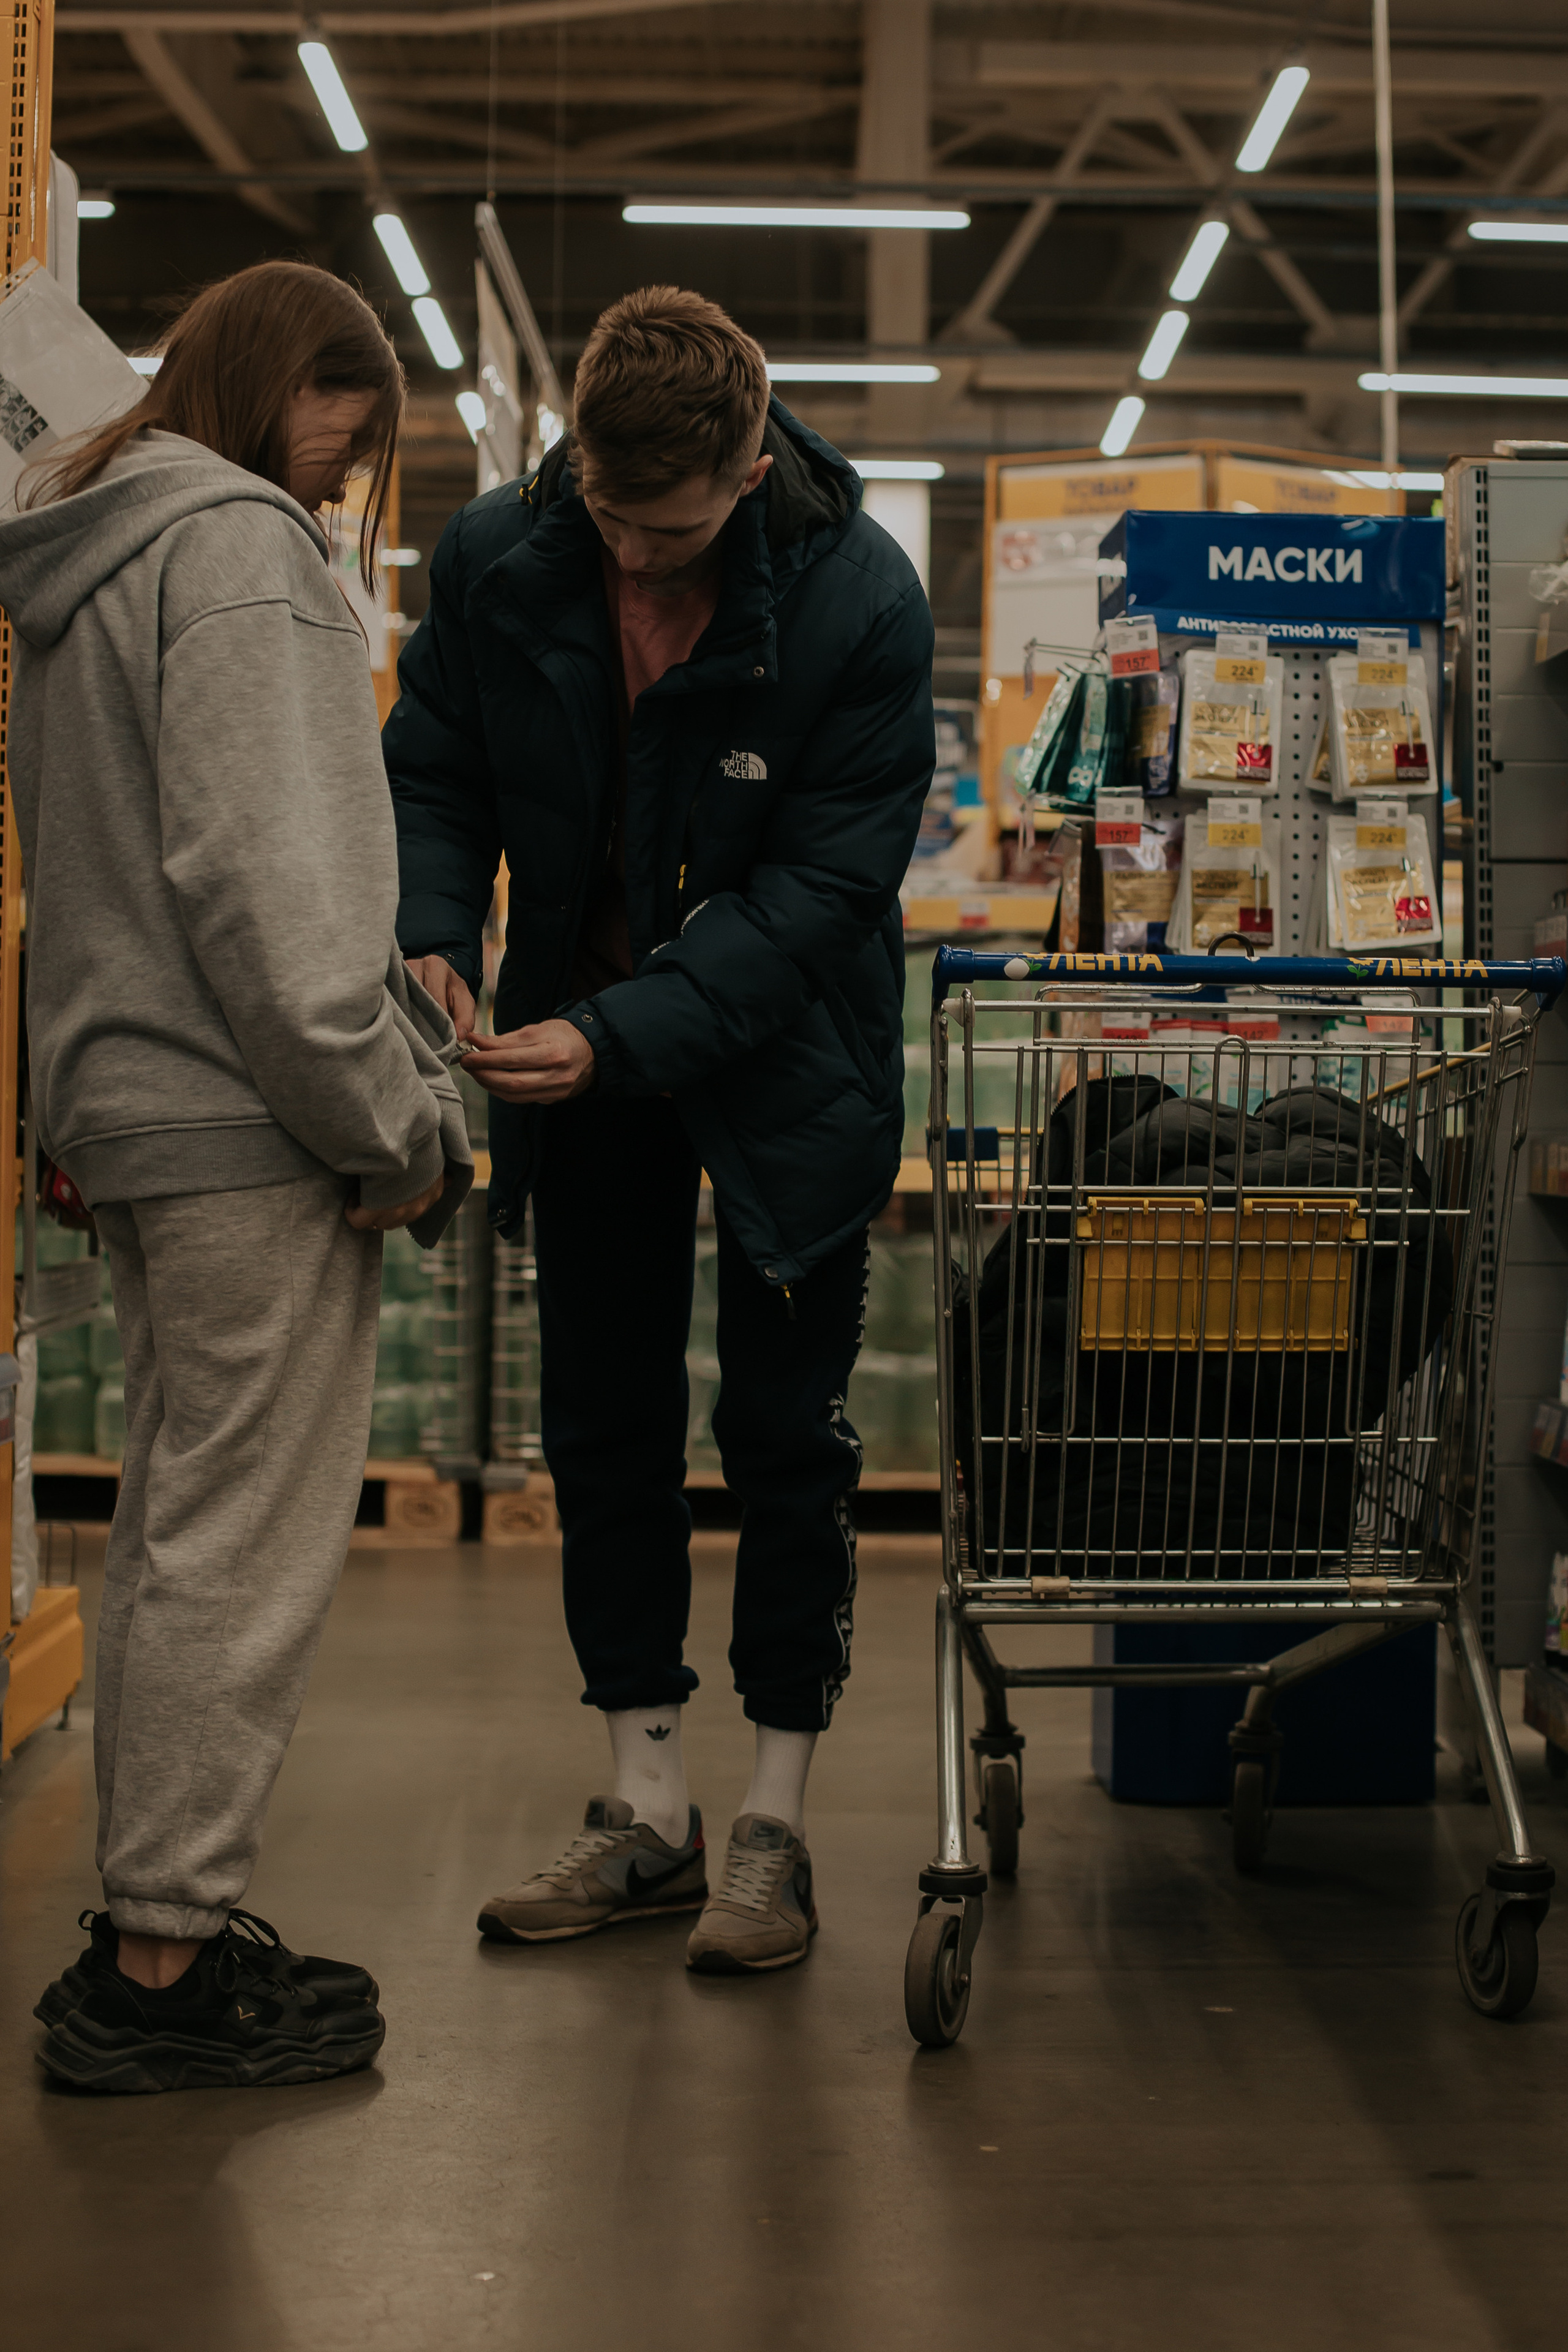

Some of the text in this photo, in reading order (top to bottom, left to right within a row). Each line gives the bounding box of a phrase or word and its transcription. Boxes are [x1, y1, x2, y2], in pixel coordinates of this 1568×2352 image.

[1208, 546, 1363, 583] МАСКИ
[1177, 616, 1359, 640] АНТИСТНОЙ УХО
[1126, 657, 1146, 669] 157
[1232, 665, 1254, 676] 224
[1371, 667, 1393, 679] 224
[731, 750, 747, 761] THE
[719, 758, 748, 771] NORTH
[724, 768, 748, 779] FACE
[1109, 830, 1128, 841] 157
[1223, 829, 1245, 840] 224
[1370, 832, 1393, 843] 224
[1048, 953, 1164, 972] ЛЕНТА
[1375, 957, 1489, 978] ЛЕНТА
